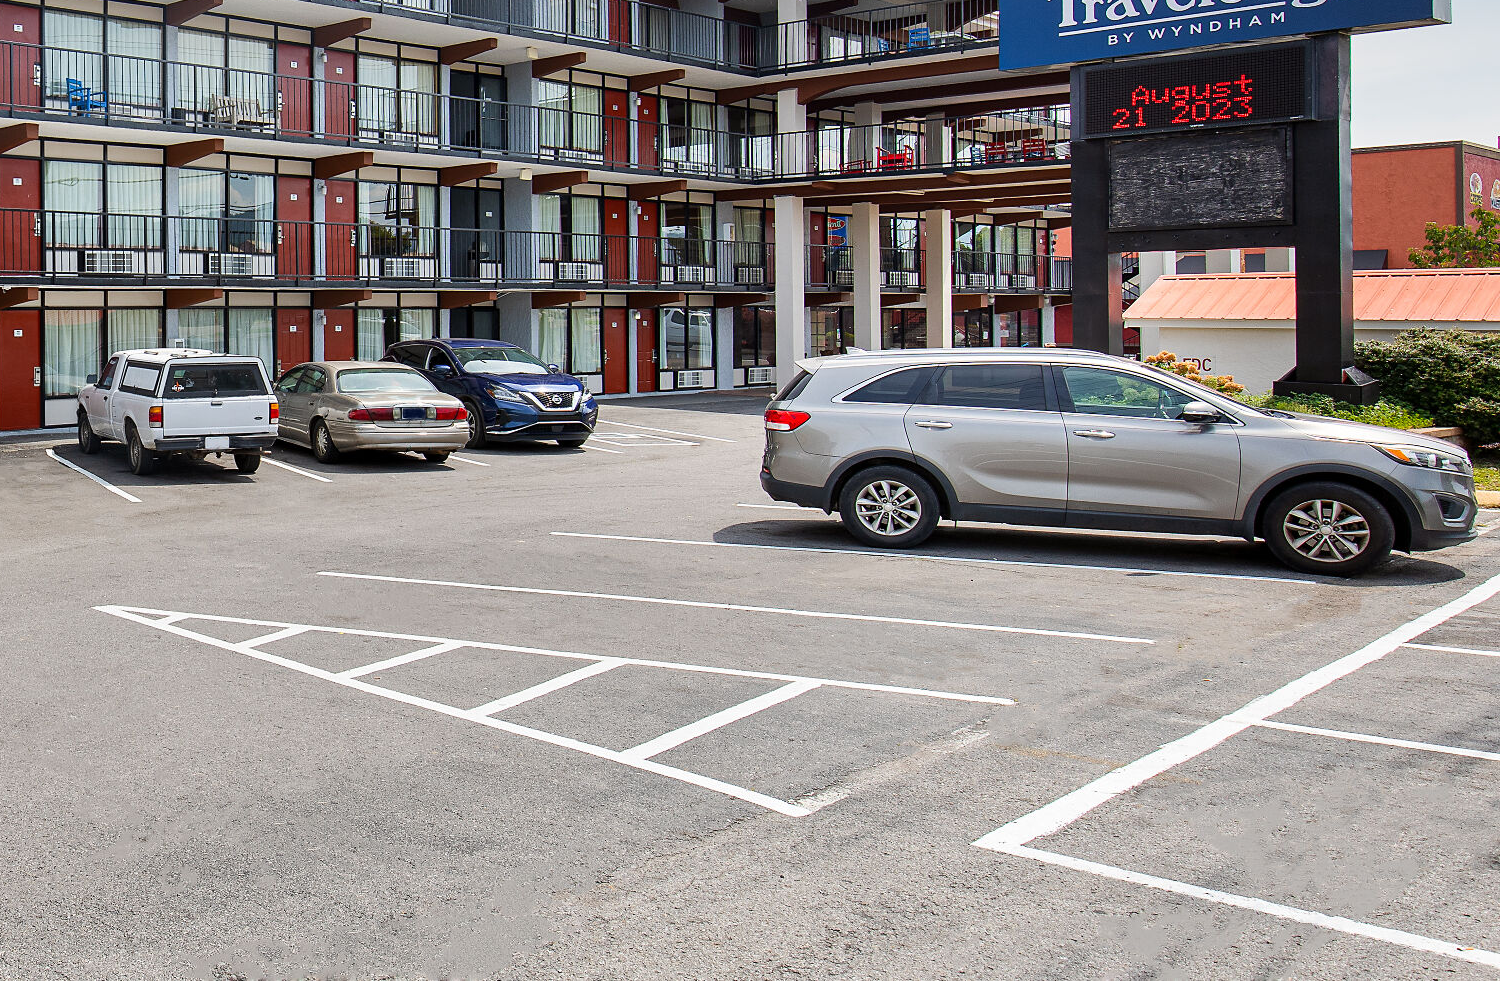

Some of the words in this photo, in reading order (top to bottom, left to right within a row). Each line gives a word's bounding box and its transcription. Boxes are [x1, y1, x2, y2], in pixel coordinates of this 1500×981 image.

[1108, 32, 1134, 46] BY
[1148, 12, 1285, 40] WYNDHAM
[1131, 74, 1253, 106] August
[1112, 107, 1147, 129] 21
[1171, 96, 1253, 124] 2023
